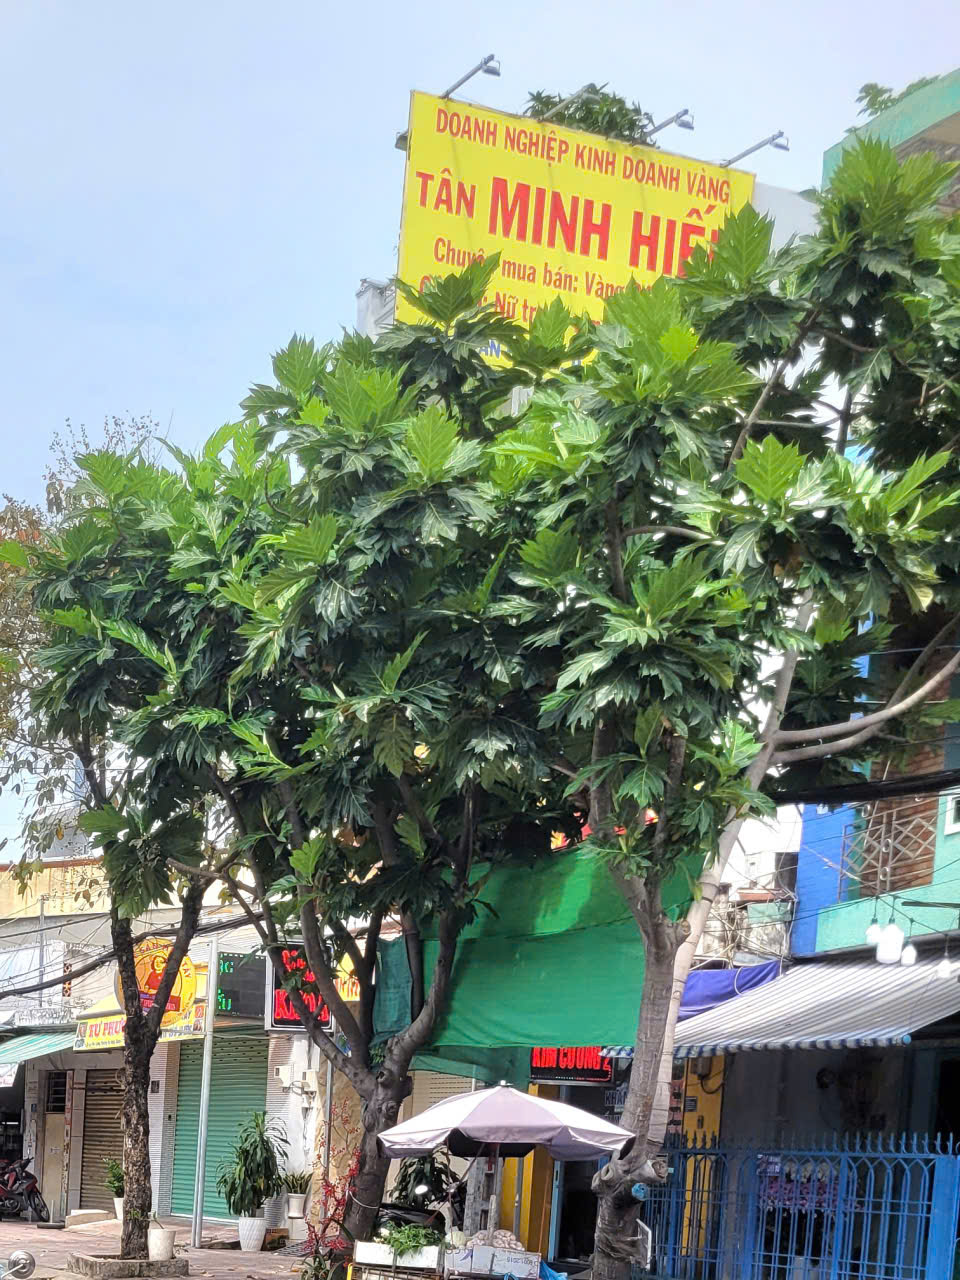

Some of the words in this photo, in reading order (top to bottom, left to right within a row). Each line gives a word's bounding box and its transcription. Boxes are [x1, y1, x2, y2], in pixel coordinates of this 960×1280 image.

[436, 107, 498, 148] DOANH
[504, 126, 570, 167] NGHIỆP
[575, 143, 617, 177] KINH
[622, 157, 681, 192] DOANH
[687, 166, 731, 204] VÀNG
[415, 167, 477, 220] TÂN
[488, 175, 612, 262] MINH
[628, 203, 721, 279] HIẾ
[501, 258, 537, 284] mua
[543, 262, 579, 293] bán:
